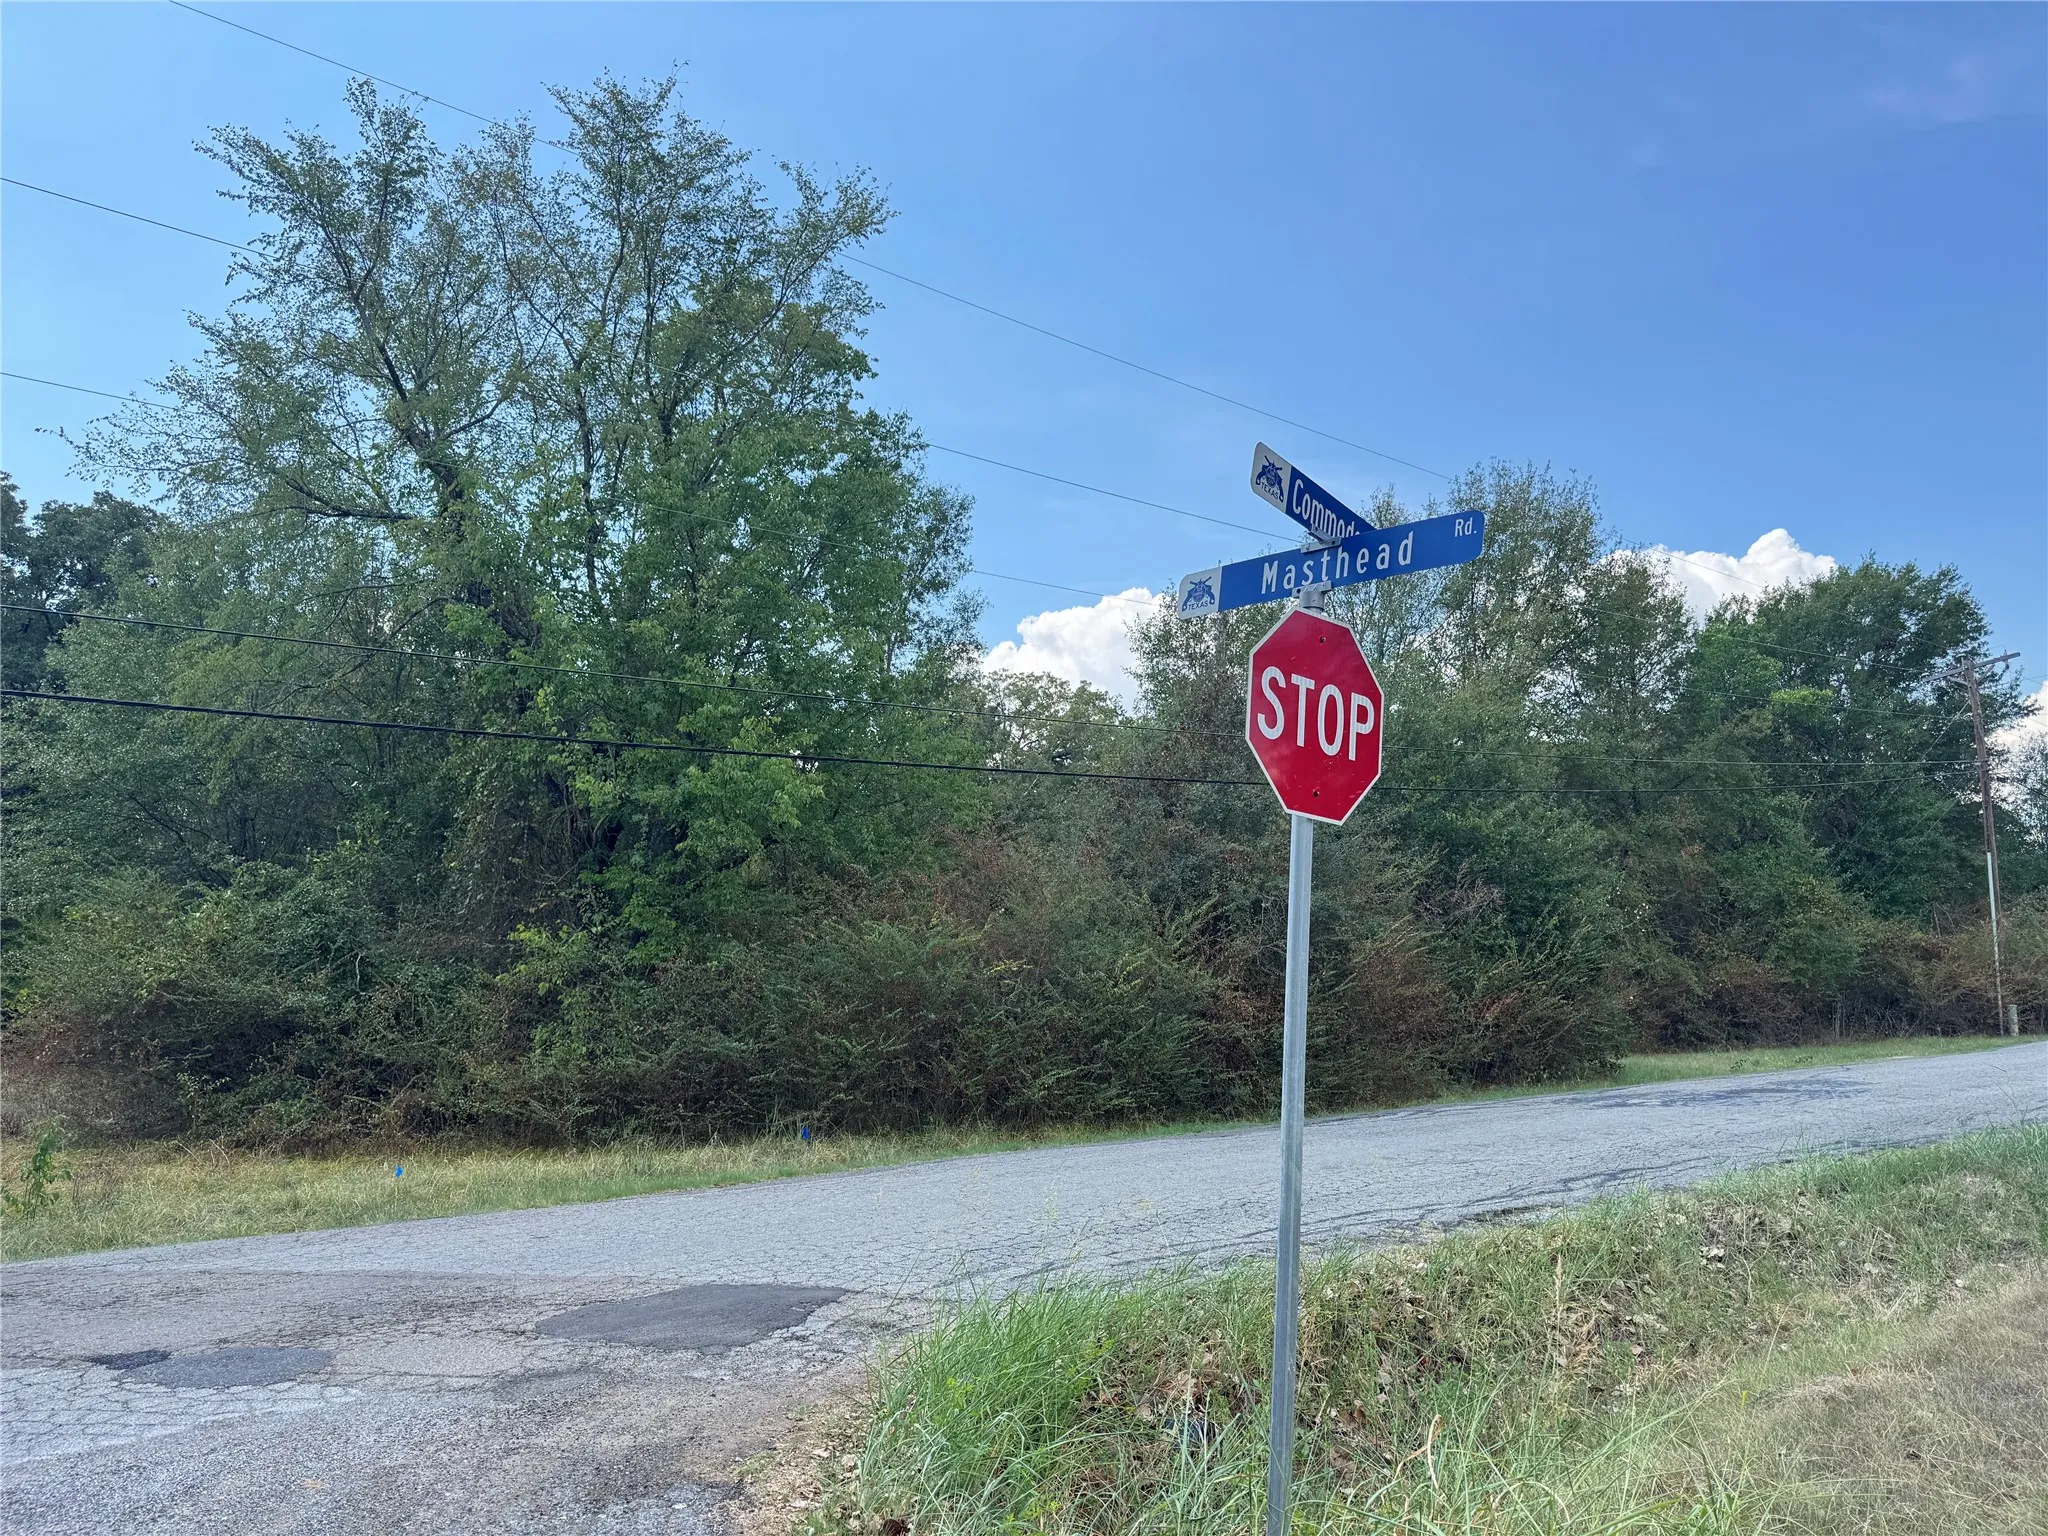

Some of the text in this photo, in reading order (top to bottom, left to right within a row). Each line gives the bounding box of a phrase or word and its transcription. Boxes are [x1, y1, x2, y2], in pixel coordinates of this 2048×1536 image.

[1261, 482, 1279, 500] TEXAS
[1292, 479, 1360, 538] Commod
[1261, 516, 1477, 594] Masthead Rd.
[1188, 600, 1209, 611] TEXAS
[1257, 666, 1375, 761] STOP
